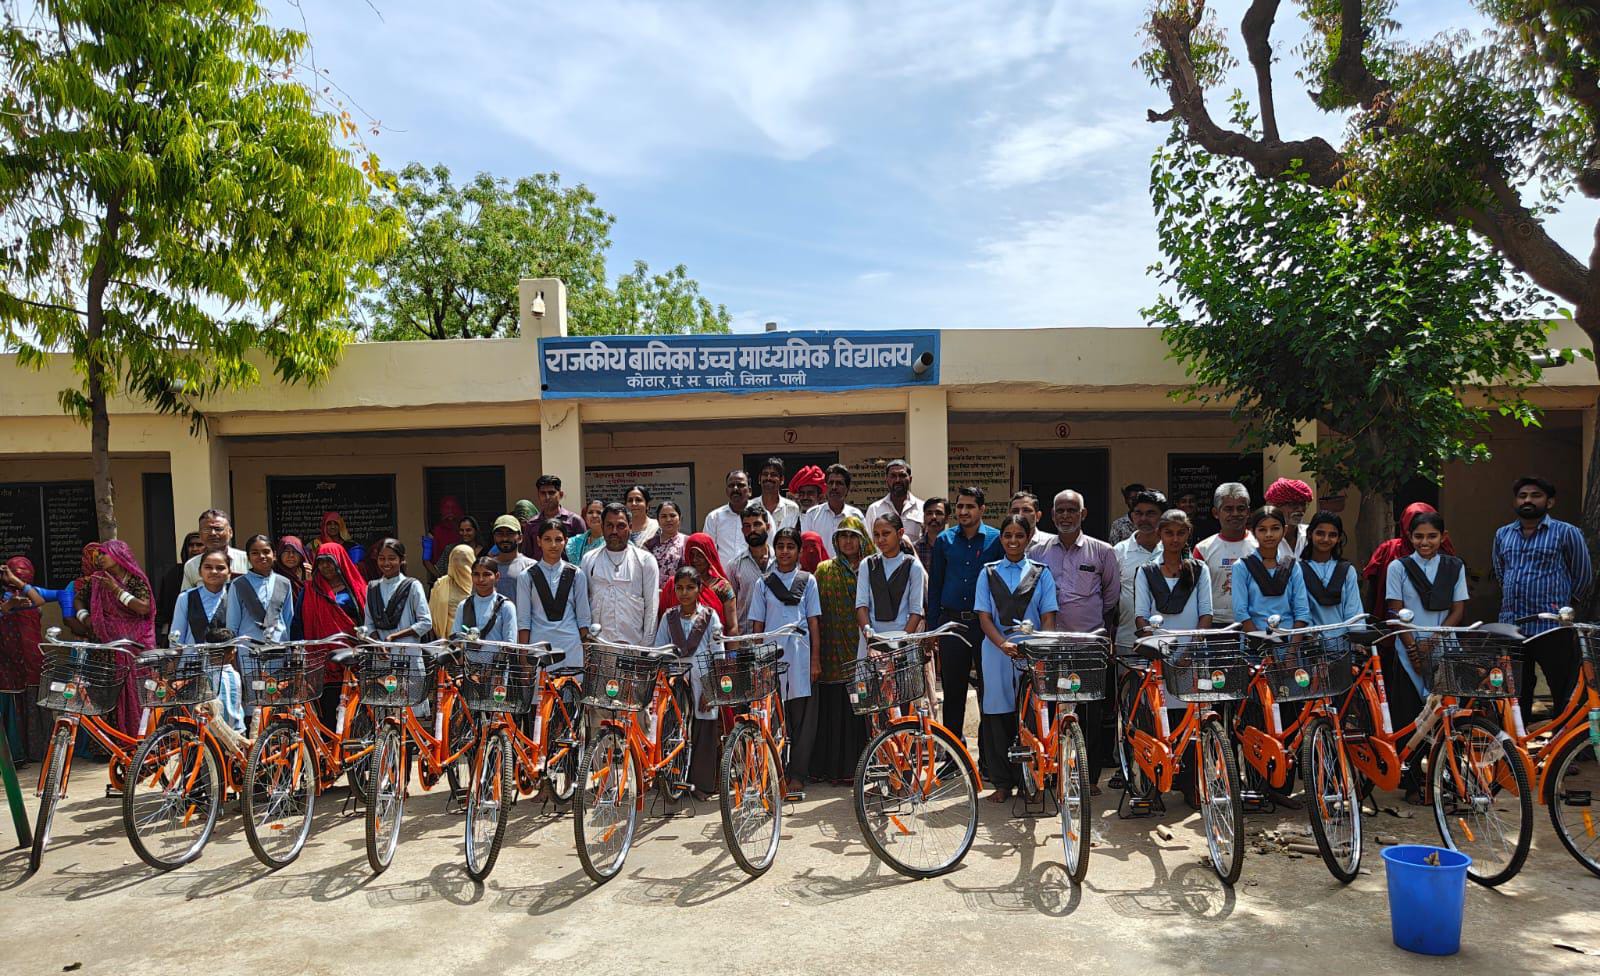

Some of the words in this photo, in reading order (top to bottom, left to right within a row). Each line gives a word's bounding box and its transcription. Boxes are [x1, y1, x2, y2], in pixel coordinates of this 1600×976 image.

[545, 341, 627, 372] राजकीय
[629, 341, 697, 371] बालिका
[698, 347, 737, 371] उच्च
[738, 338, 830, 370] माध्यमिक
[833, 337, 913, 368] विद्यालय
[626, 373, 670, 389] कोठार,
[740, 371, 772, 386] जिला
[779, 370, 807, 386] पाली
